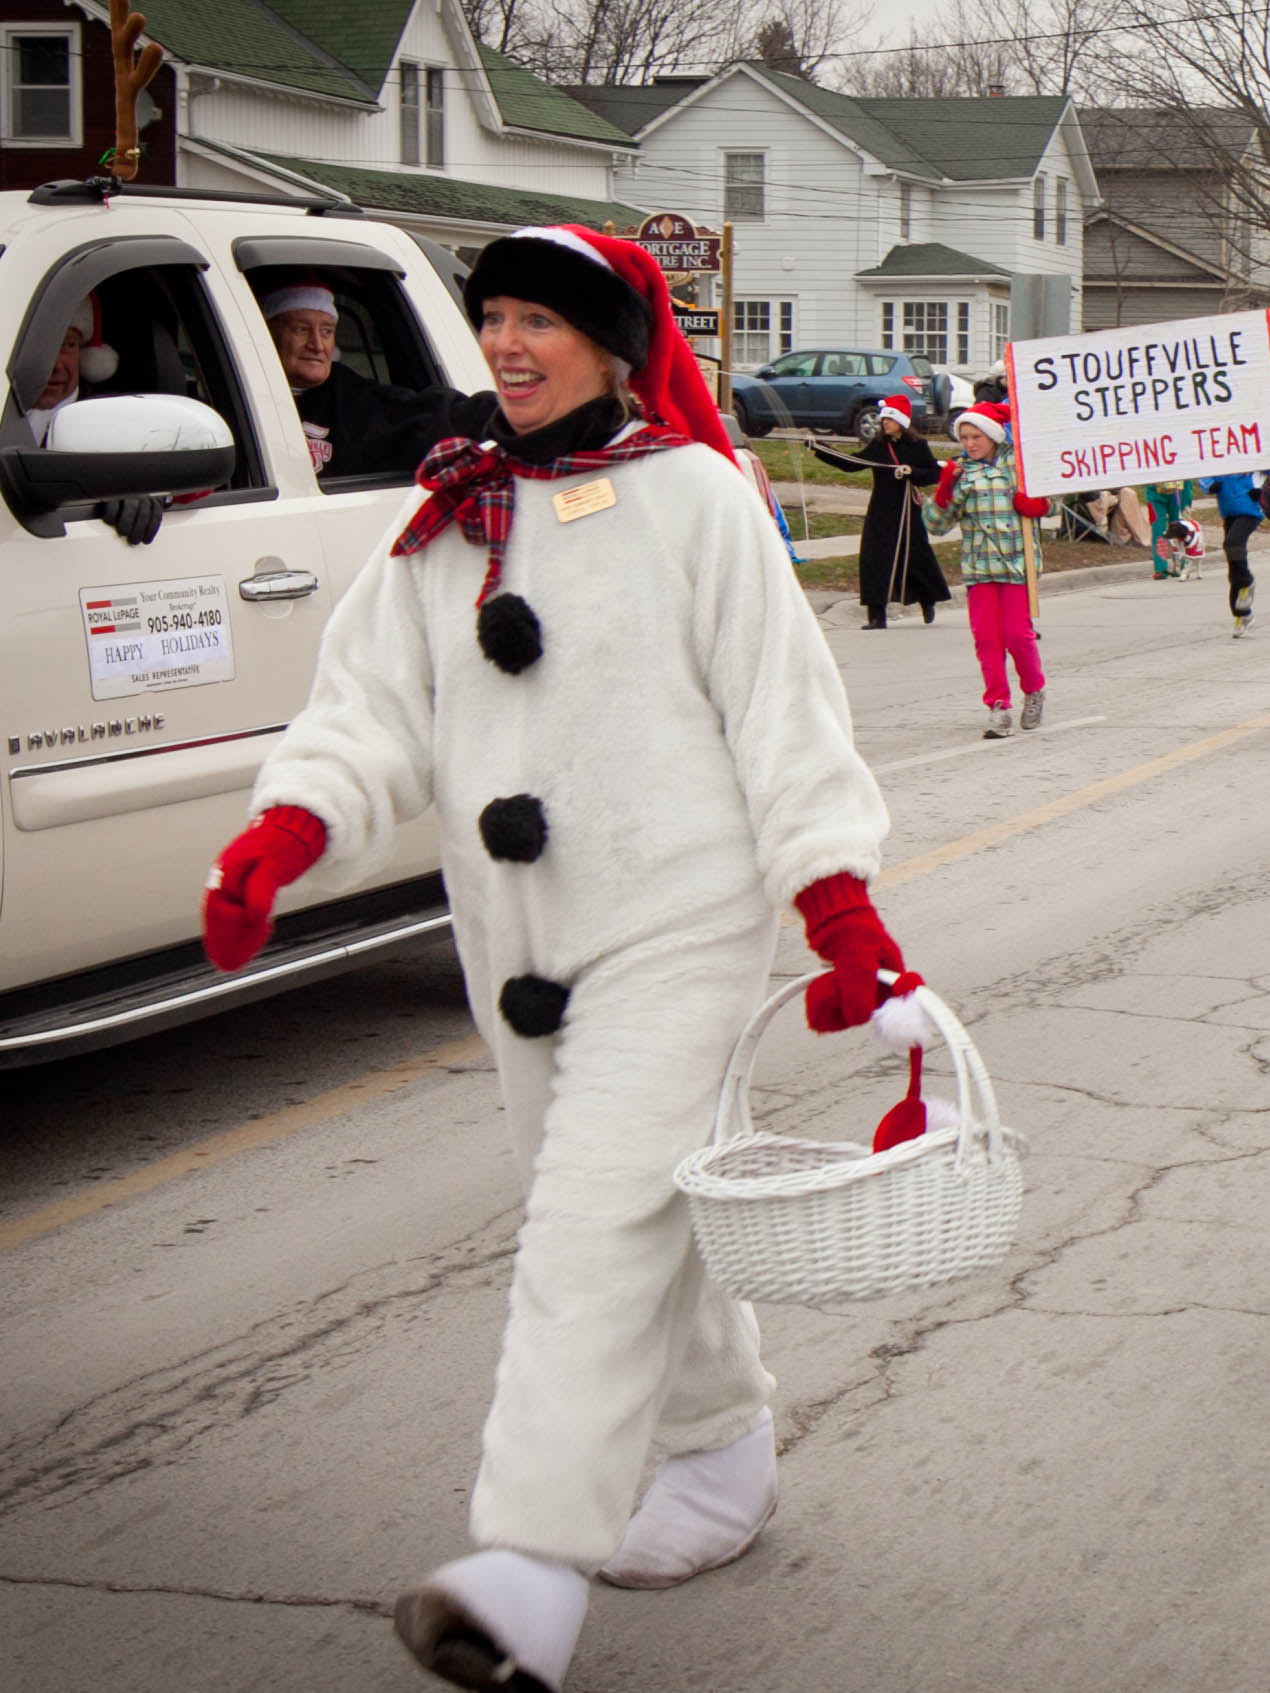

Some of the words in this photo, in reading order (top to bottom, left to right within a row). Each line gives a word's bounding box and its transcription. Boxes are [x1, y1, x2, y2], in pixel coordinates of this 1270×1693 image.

[637, 241, 711, 256] ORTGAGE
[673, 316, 717, 328] TREET
[1034, 332, 1247, 390] STOUFFVILLE
[1074, 370, 1232, 421] STEPPERS
[1060, 434, 1178, 478] SKIPPING
[1191, 422, 1262, 460] TEAM
[158, 588, 198, 601] Community
[88, 610, 112, 623] ROYAL
[147, 609, 222, 634] 905-940-4180
[105, 643, 143, 664] HAPPY
[161, 631, 219, 655] HOLIDAYS
[27, 713, 167, 751] AVALANCHE
